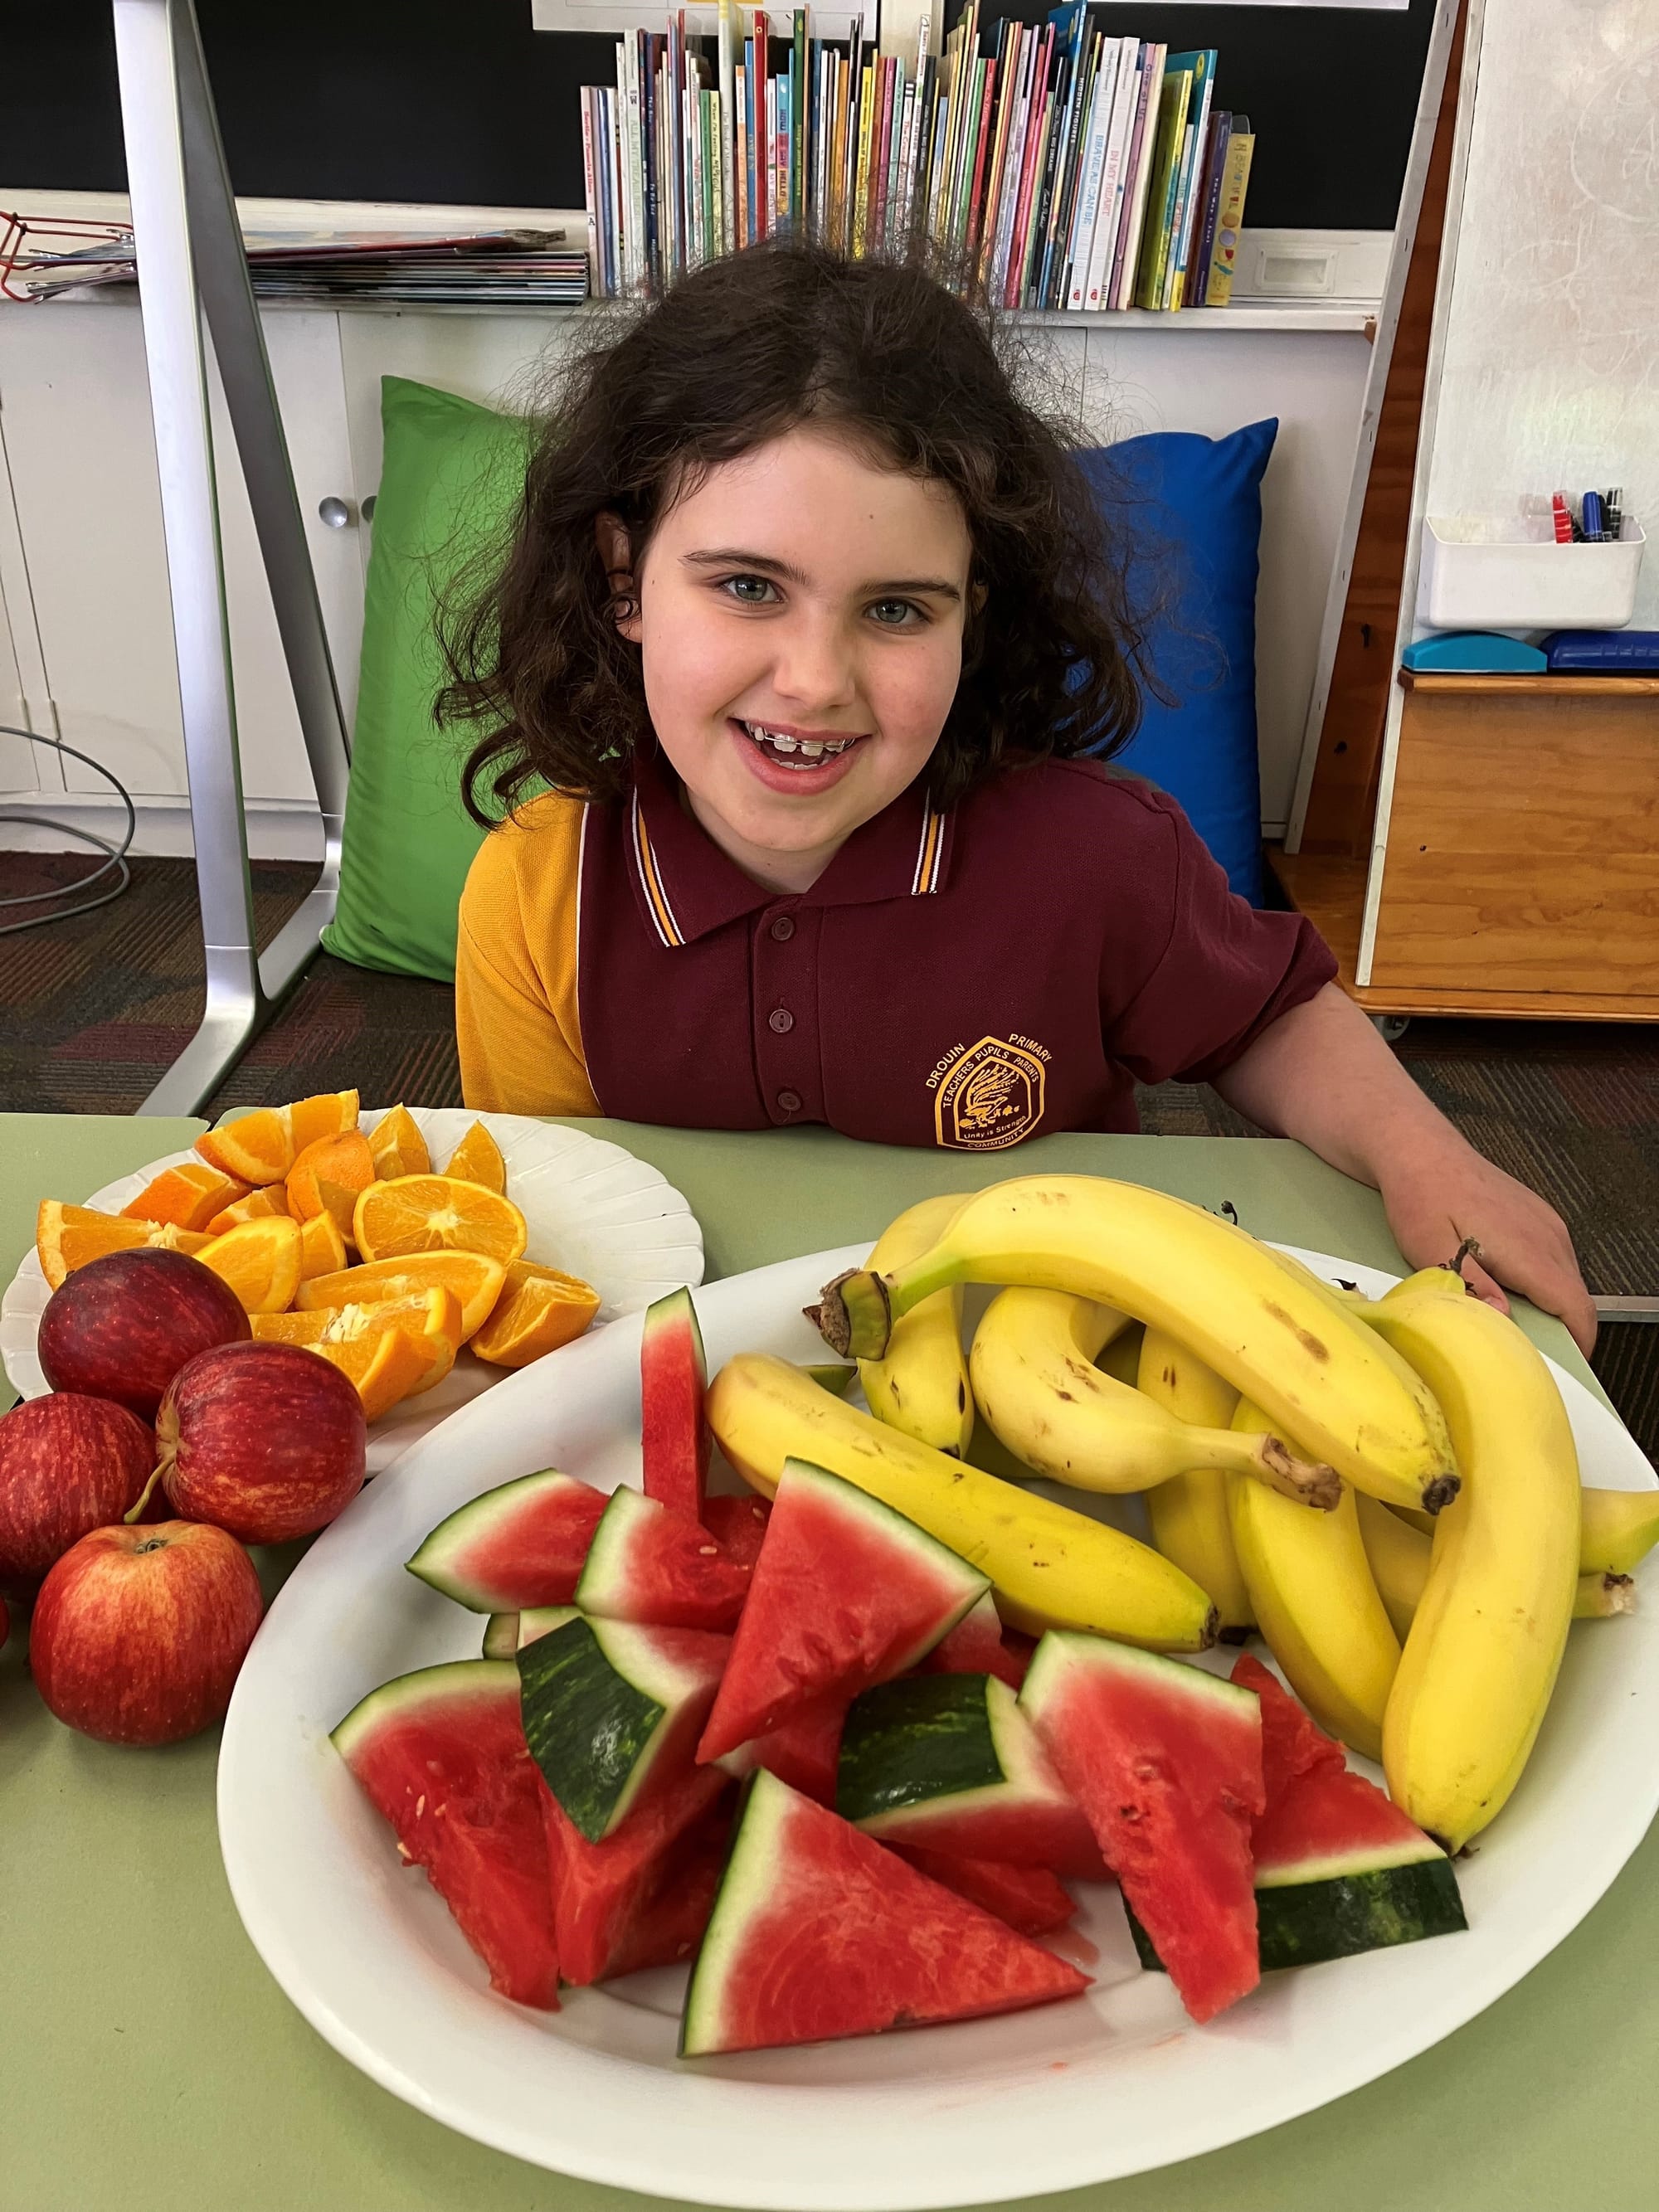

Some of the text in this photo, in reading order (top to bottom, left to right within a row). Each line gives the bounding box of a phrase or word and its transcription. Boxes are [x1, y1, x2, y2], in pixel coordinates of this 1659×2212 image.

[1070, 77, 1084, 143] HIDDEN FIGURES
[1138, 64, 1152, 120] One of Us
[631, 141, 639, 157] MY
[1083, 134, 1104, 225] BRAVE AS CAN BE
[1102, 150, 1119, 217] IN MY HEART
[588, 217, 596, 226] A
[926, 1033, 1053, 1089] DROUIN PRIMARY
[942, 1045, 1039, 1109] TEACHERS PUPILS PARENTS
[964, 1131, 985, 1140] Unity
[996, 1116, 1027, 1132] Strength
[967, 1128, 1025, 1148] COMMUNITY
